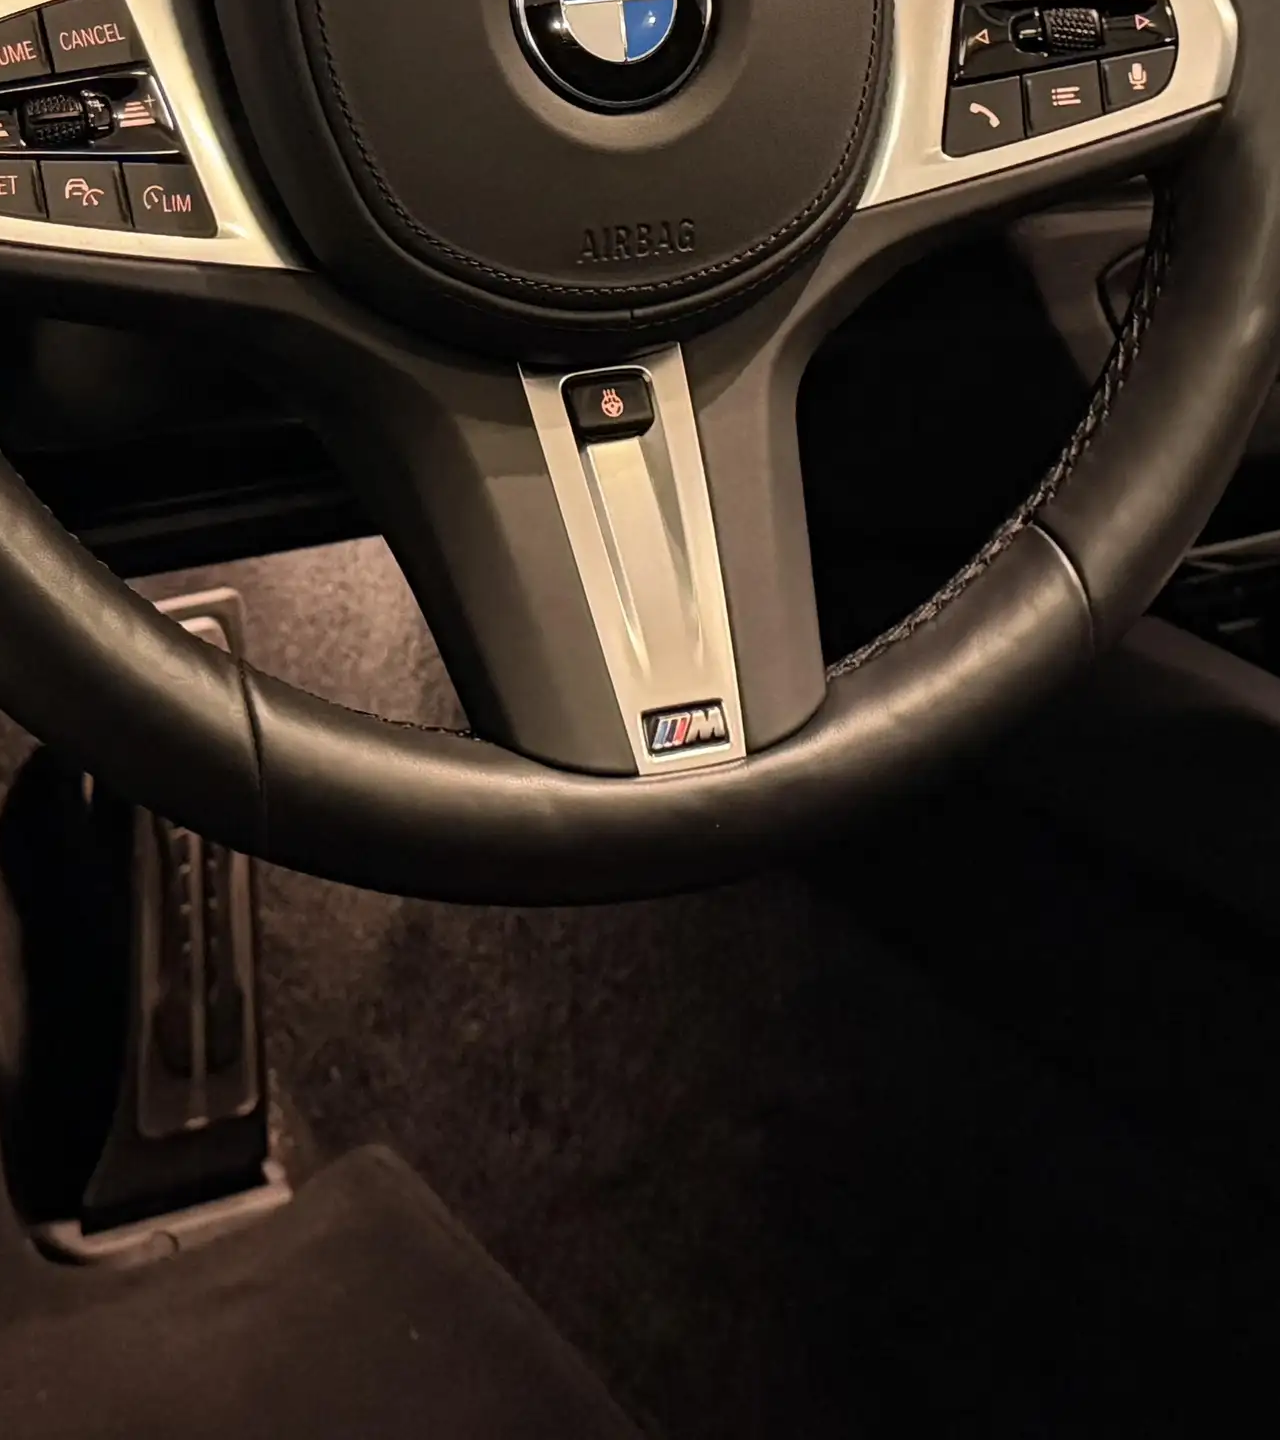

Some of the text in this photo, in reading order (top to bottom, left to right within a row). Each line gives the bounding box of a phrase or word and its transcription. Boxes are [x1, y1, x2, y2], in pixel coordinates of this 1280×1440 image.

[59, 22, 126, 52] CANCEL
[162, 194, 192, 213] LIM
[578, 218, 697, 263] AIRBAG
